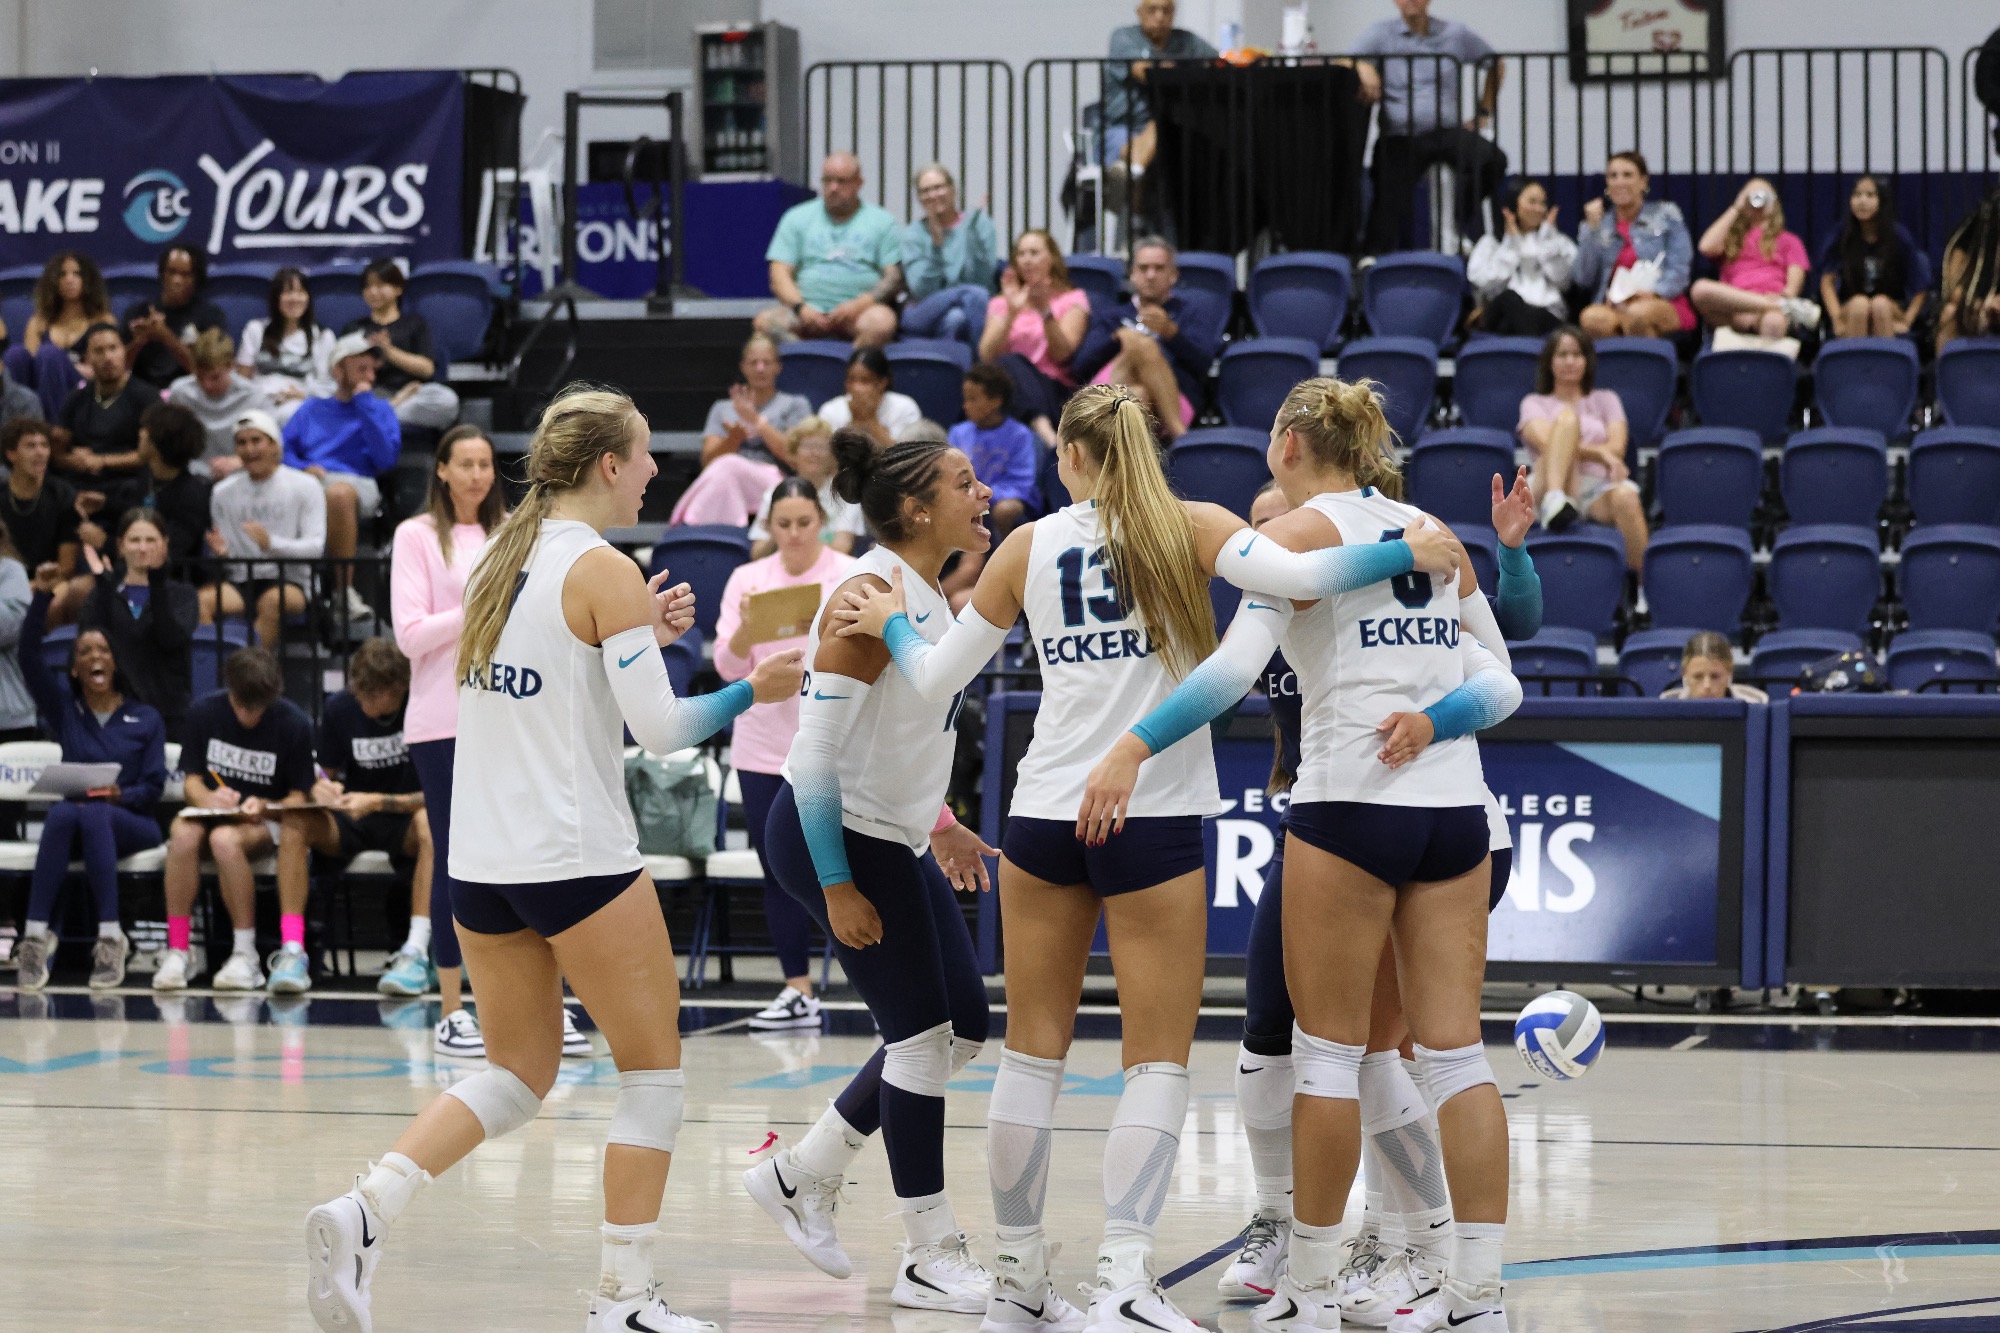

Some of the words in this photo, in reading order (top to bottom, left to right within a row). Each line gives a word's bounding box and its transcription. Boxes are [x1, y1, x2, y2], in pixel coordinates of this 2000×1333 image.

[156, 187, 192, 218] EC
[1056, 540, 1136, 628] 13
[1358, 616, 1460, 650] ECKERD
[1498, 793, 1593, 817] LEGE
